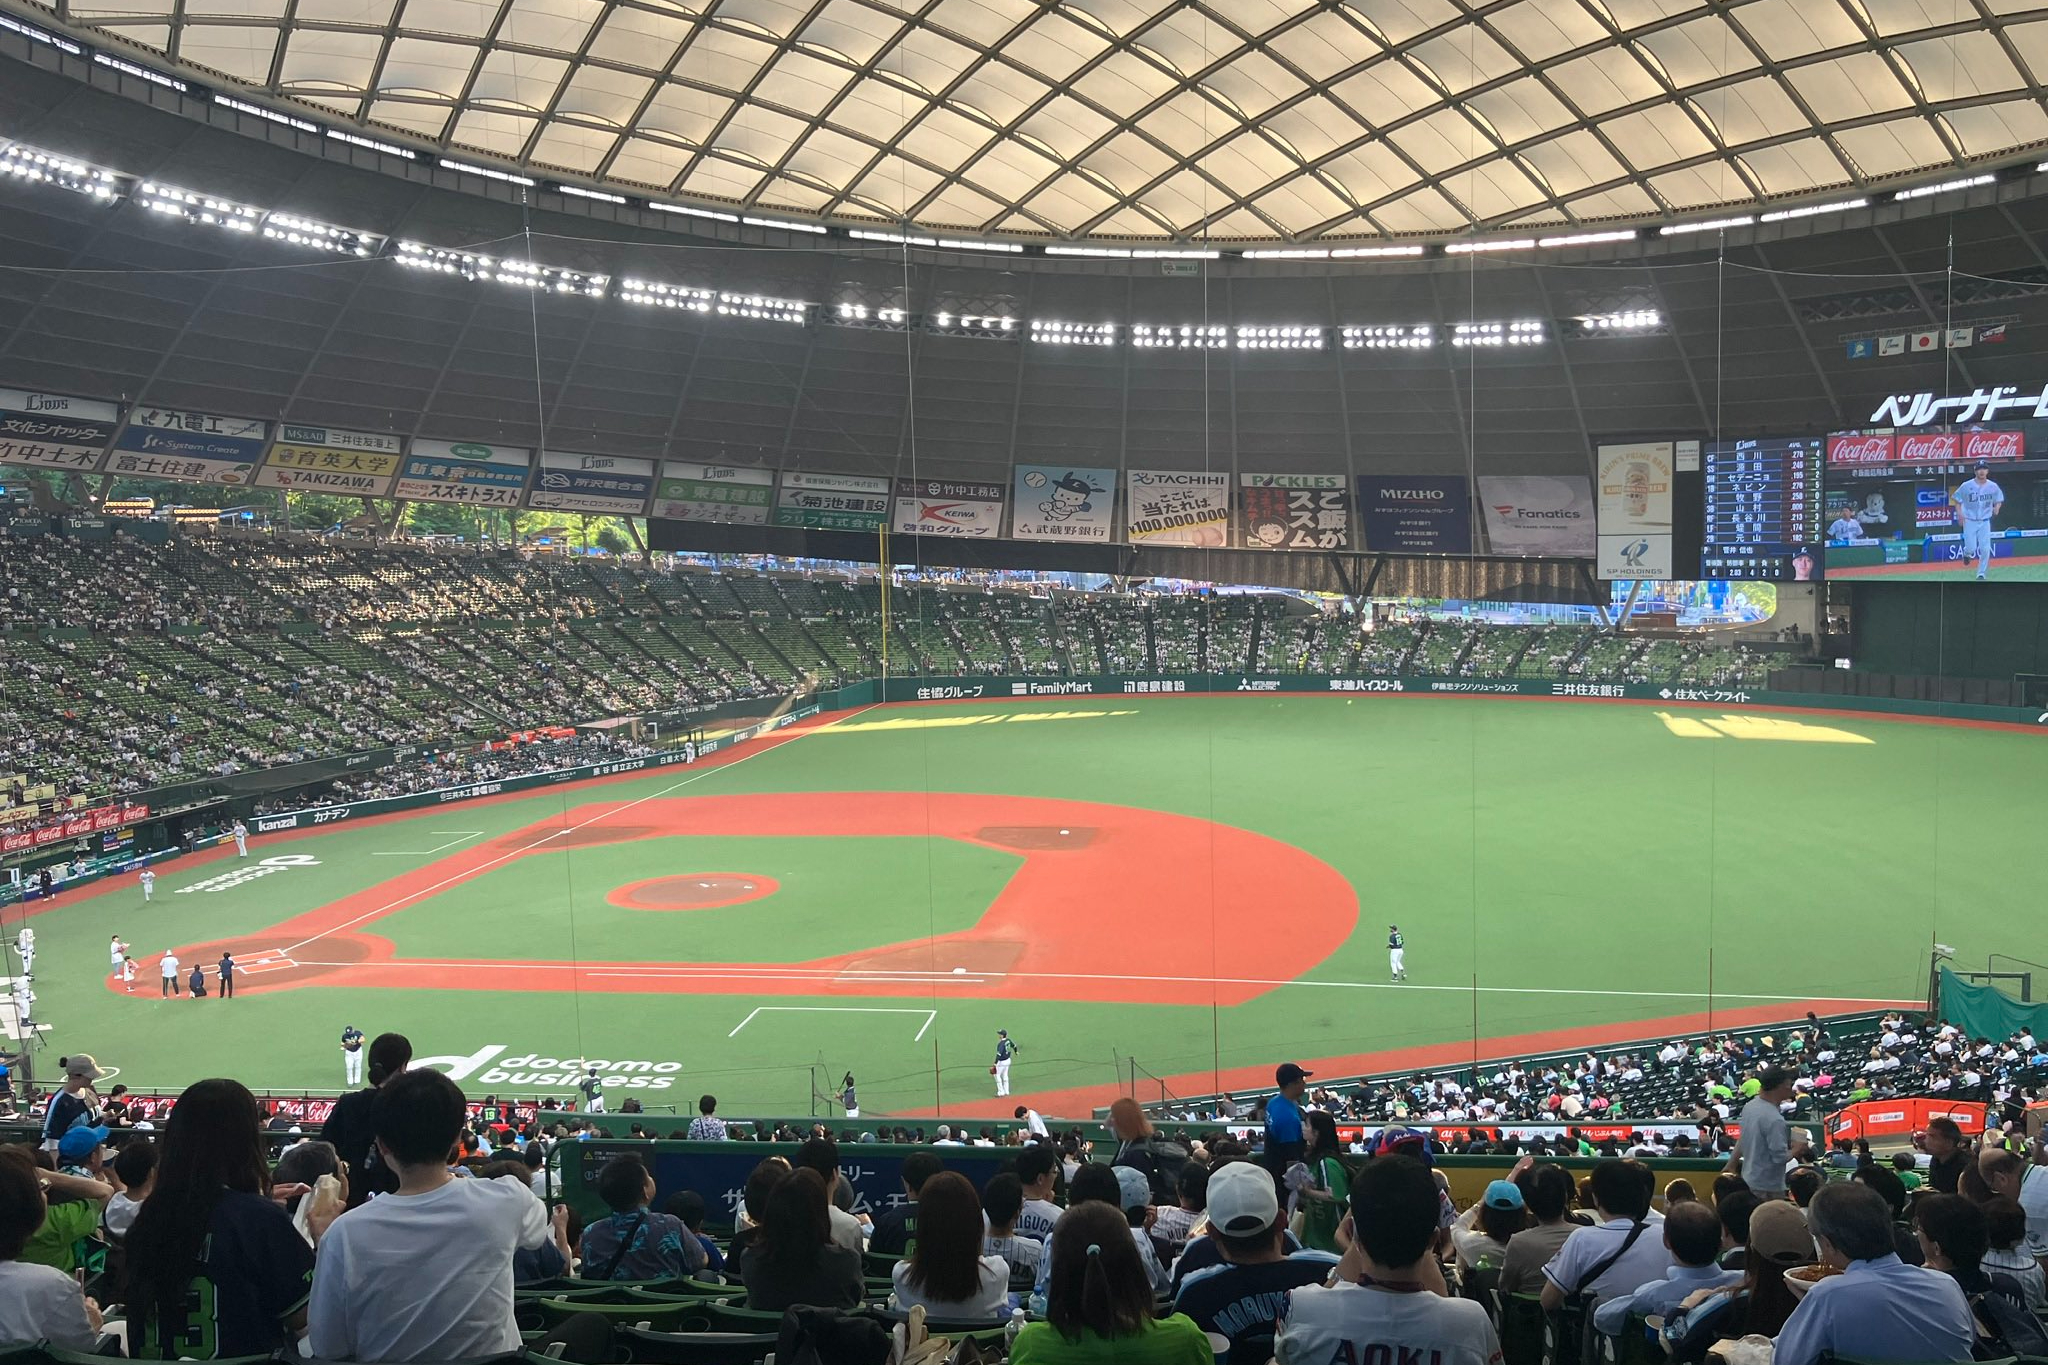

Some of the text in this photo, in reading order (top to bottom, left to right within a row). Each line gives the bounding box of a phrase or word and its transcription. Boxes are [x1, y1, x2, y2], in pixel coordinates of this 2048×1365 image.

[25, 395, 69, 411] Lions
[1, 419, 106, 440] 文化シャッター
[163, 411, 224, 434] 九電工
[287, 429, 323, 440] MS&AD
[331, 432, 394, 449] 三井住友海上
[166, 440, 240, 455] System Create
[1833, 437, 1889, 461] Coca-Cola
[1901, 436, 1957, 459] Coca-Cola
[1967, 434, 2018, 457] Coca-Cola
[116, 456, 206, 477] 富士住建
[297, 450, 389, 472] 育英大学
[580, 456, 614, 470] Lions
[293, 471, 375, 488] TAKIZAWA
[702, 467, 735, 480] Lions
[1154, 473, 1224, 485] TACHIHI
[428, 485, 518, 503] スズキトラスト
[944, 484, 1001, 498] 竹中工務店
[1159, 490, 1195, 502] ここに
[1381, 489, 1444, 500] MIZUHO
[802, 495, 886, 512] 菊池建設
[944, 510, 975, 518] KEIWA
[1288, 491, 1317, 548] ススム
[1317, 489, 1347, 549] ご飯が
[1517, 507, 1581, 520] Fanatics
[1128, 508, 1228, 535] ¥100,000,000
[1035, 524, 1105, 537] 武蔵野銀行
[917, 685, 983, 699] 住協グループ
[1030, 681, 1093, 695] FamilyMart
[1137, 680, 1185, 693] 鹿島建設
[1329, 679, 1403, 692] 東進ハイスクール
[1431, 681, 1519, 693] 伊藤忠テクノソリューションズ
[1551, 683, 1625, 698] 三井住友銀行
[1674, 689, 1750, 704] 住友ベークライト
[95, 812, 120, 828] Coca-Cola
[123, 806, 146, 821] Coca-Cola
[314, 808, 350, 823] カナデン
[36, 826, 62, 843] Coca-Cola
[66, 819, 92, 836] Coca-Cola
[4, 833, 31, 850] Coca-Cola
[499, 1054, 683, 1073] docomo
[485, 1111, 495, 1121] 19
